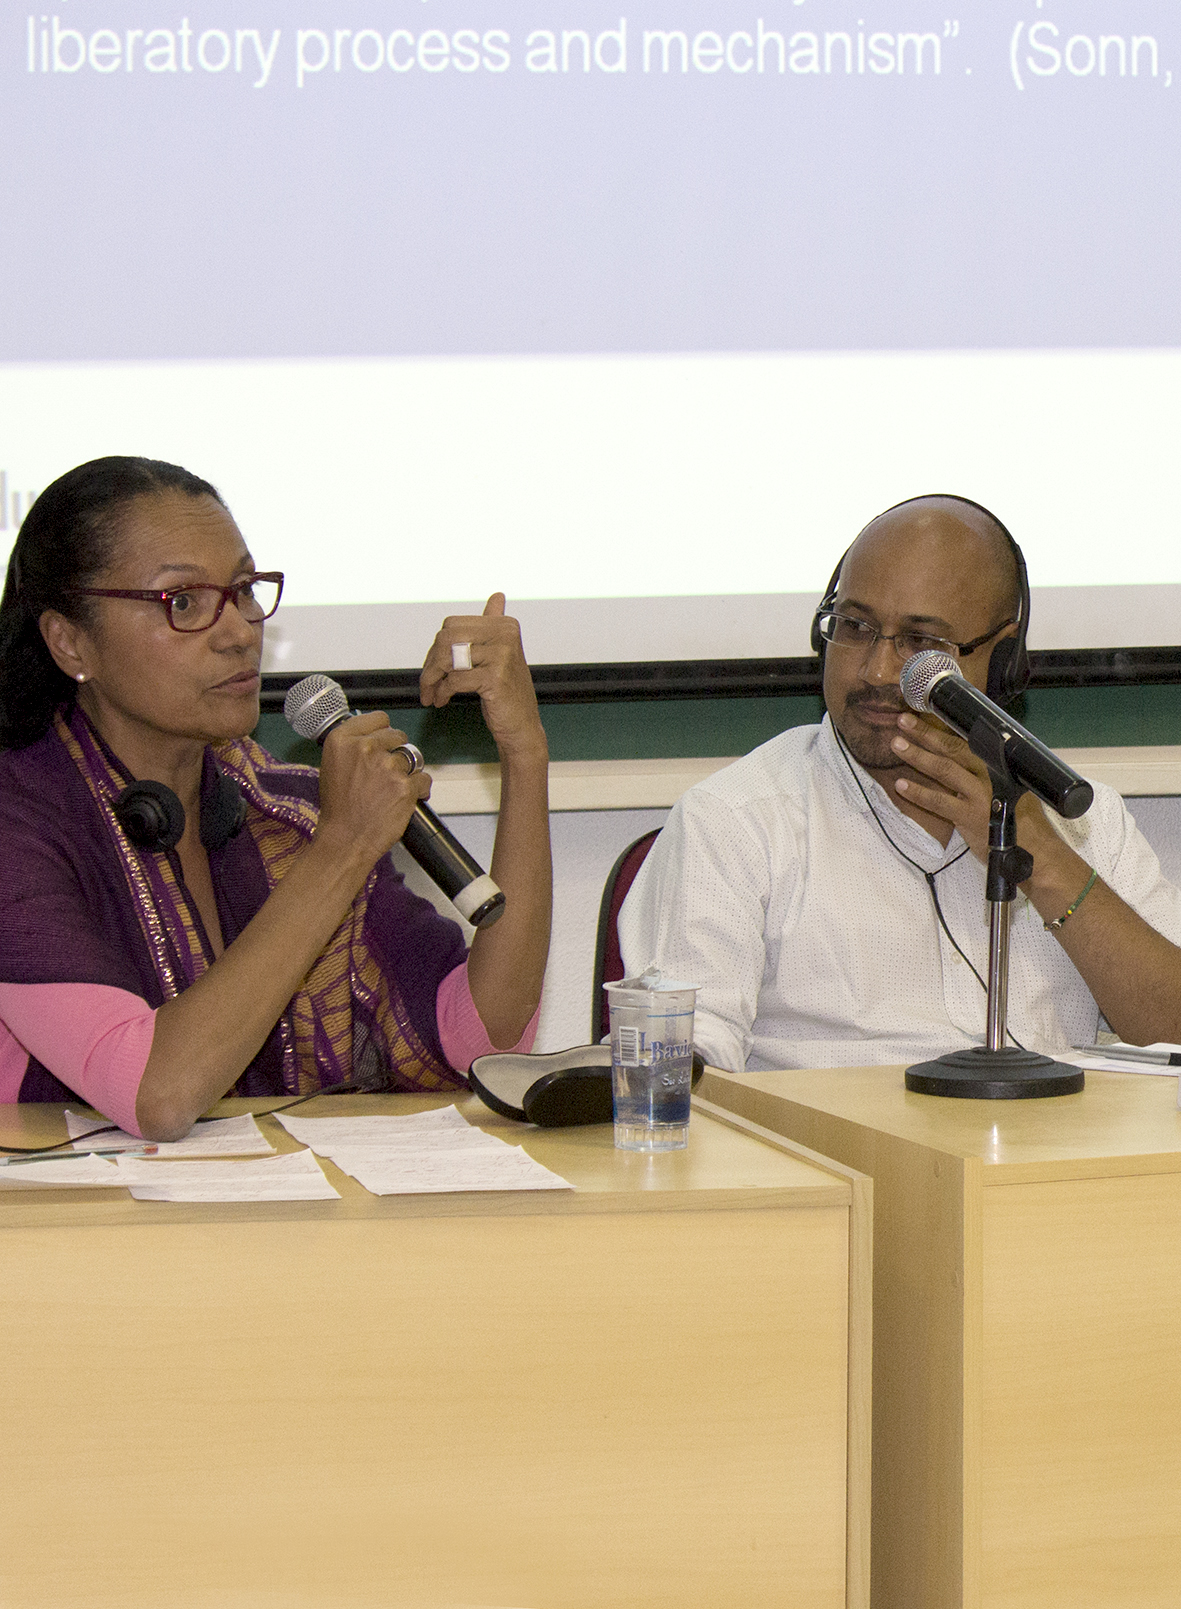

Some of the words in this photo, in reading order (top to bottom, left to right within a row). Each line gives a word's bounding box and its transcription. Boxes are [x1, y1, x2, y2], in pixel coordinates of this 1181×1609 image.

[27, 18, 282, 88] liberatory
[295, 27, 511, 88] process
[524, 17, 627, 72] and
[1009, 20, 1173, 90] (Sonn,
